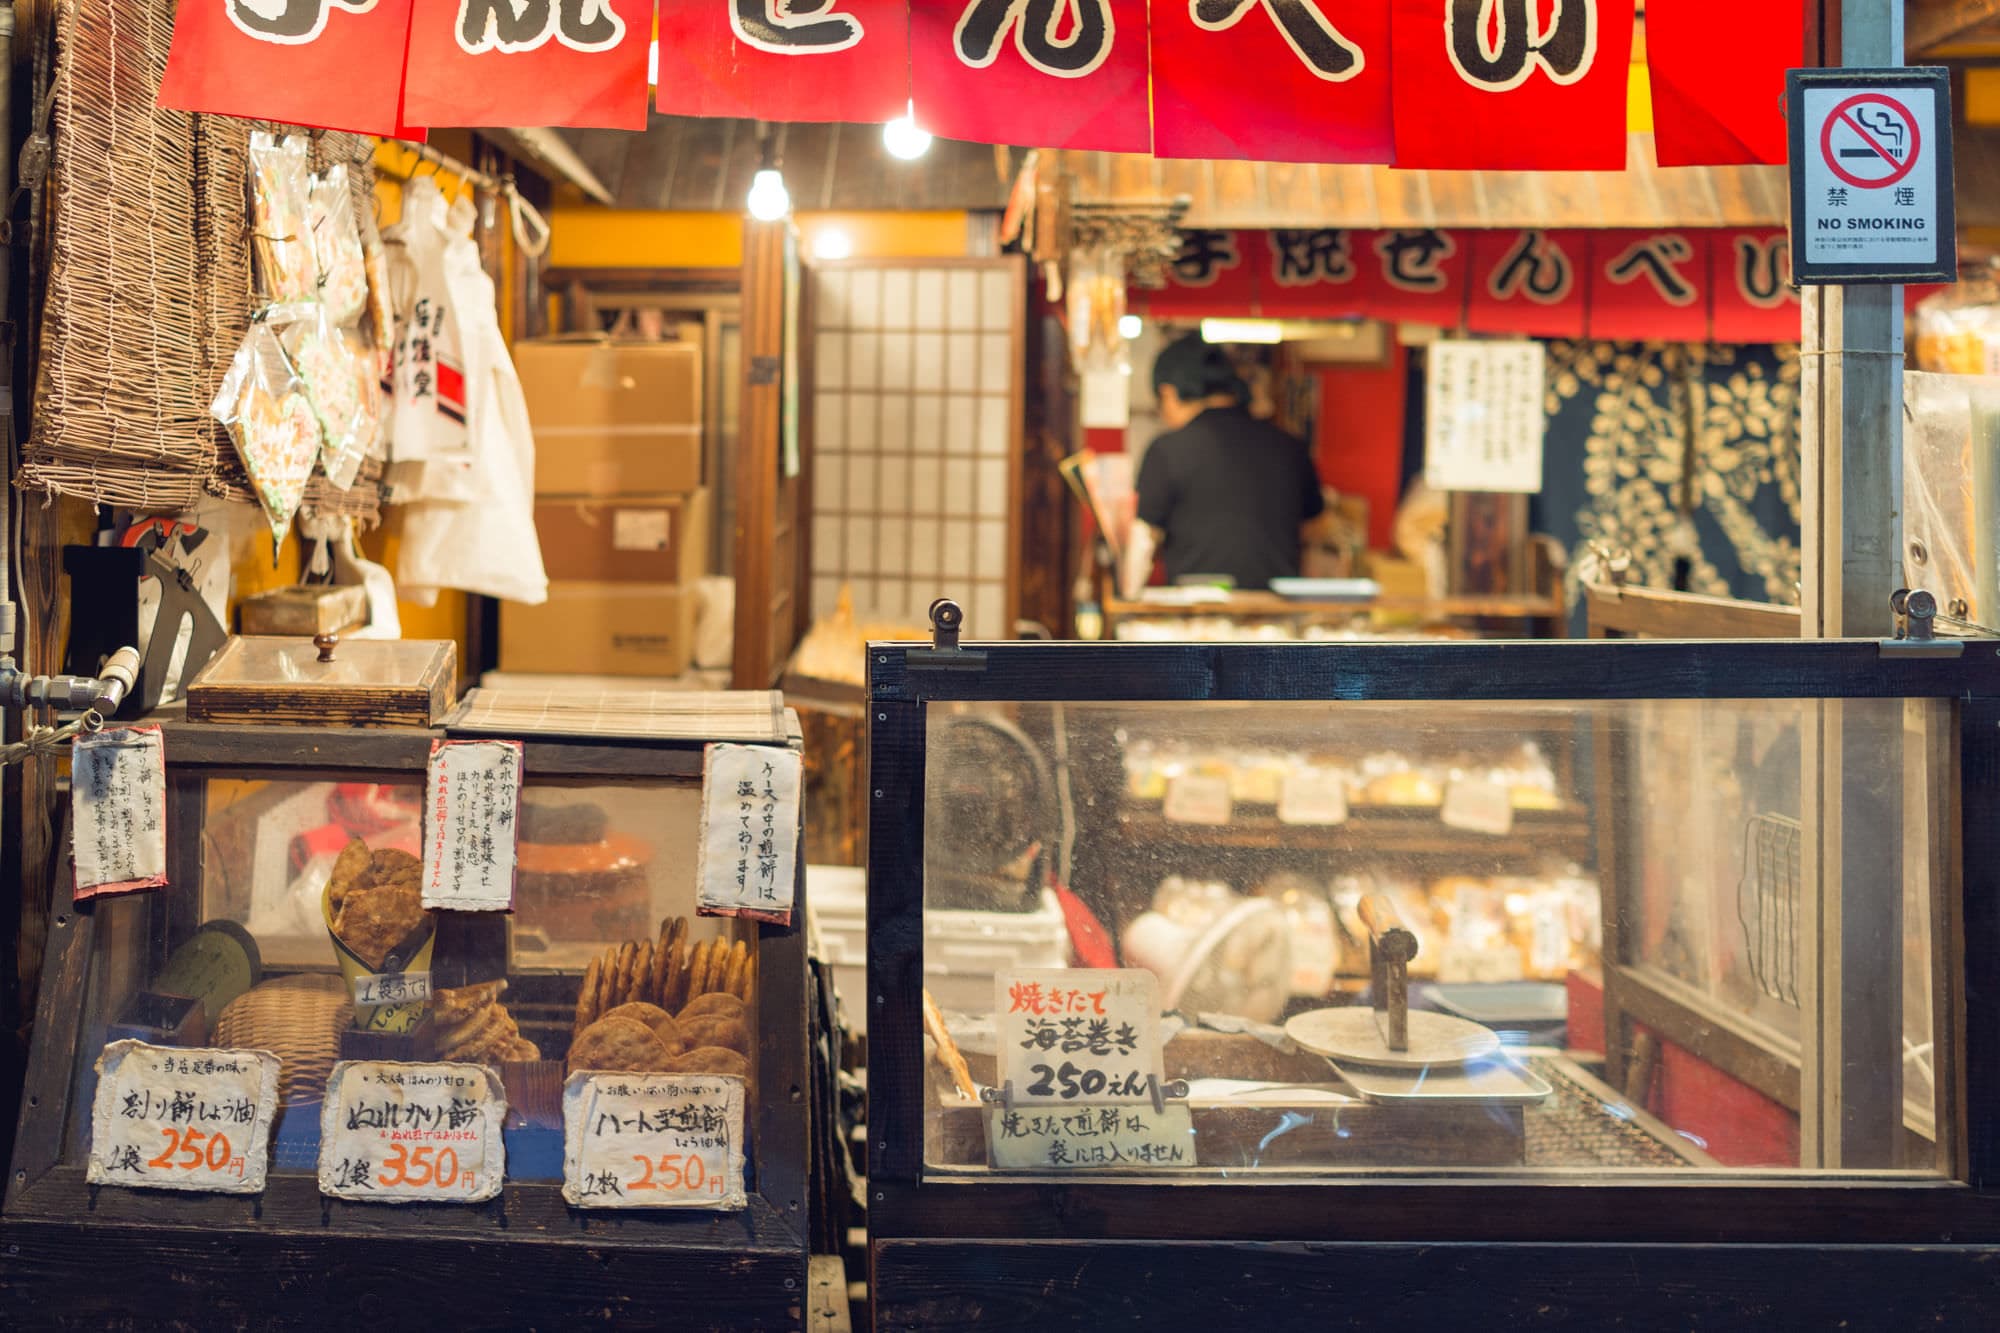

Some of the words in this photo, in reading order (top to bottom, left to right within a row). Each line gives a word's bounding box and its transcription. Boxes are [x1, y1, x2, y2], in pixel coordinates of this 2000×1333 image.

[1827, 187, 1915, 206] 禁煙
[1818, 218, 1841, 229] NO
[1848, 218, 1925, 229] SMOKING
[736, 781, 757, 894] 温めております
[757, 762, 778, 900] ケースの中の煎餅は
[1009, 981, 1108, 1015] 焼きたて
[1020, 1017, 1138, 1055] 海苔巻き
[1027, 1061, 1147, 1099] 250えん
[121, 1089, 256, 1126] 割り餅しょう油
[347, 1098, 478, 1130] ぬれかり餅
[596, 1103, 728, 1136] ハート型煎餅
[1001, 1108, 1149, 1139] 焼きたて煎餅は
[1048, 1140, 1183, 1164] 袋には入りません
